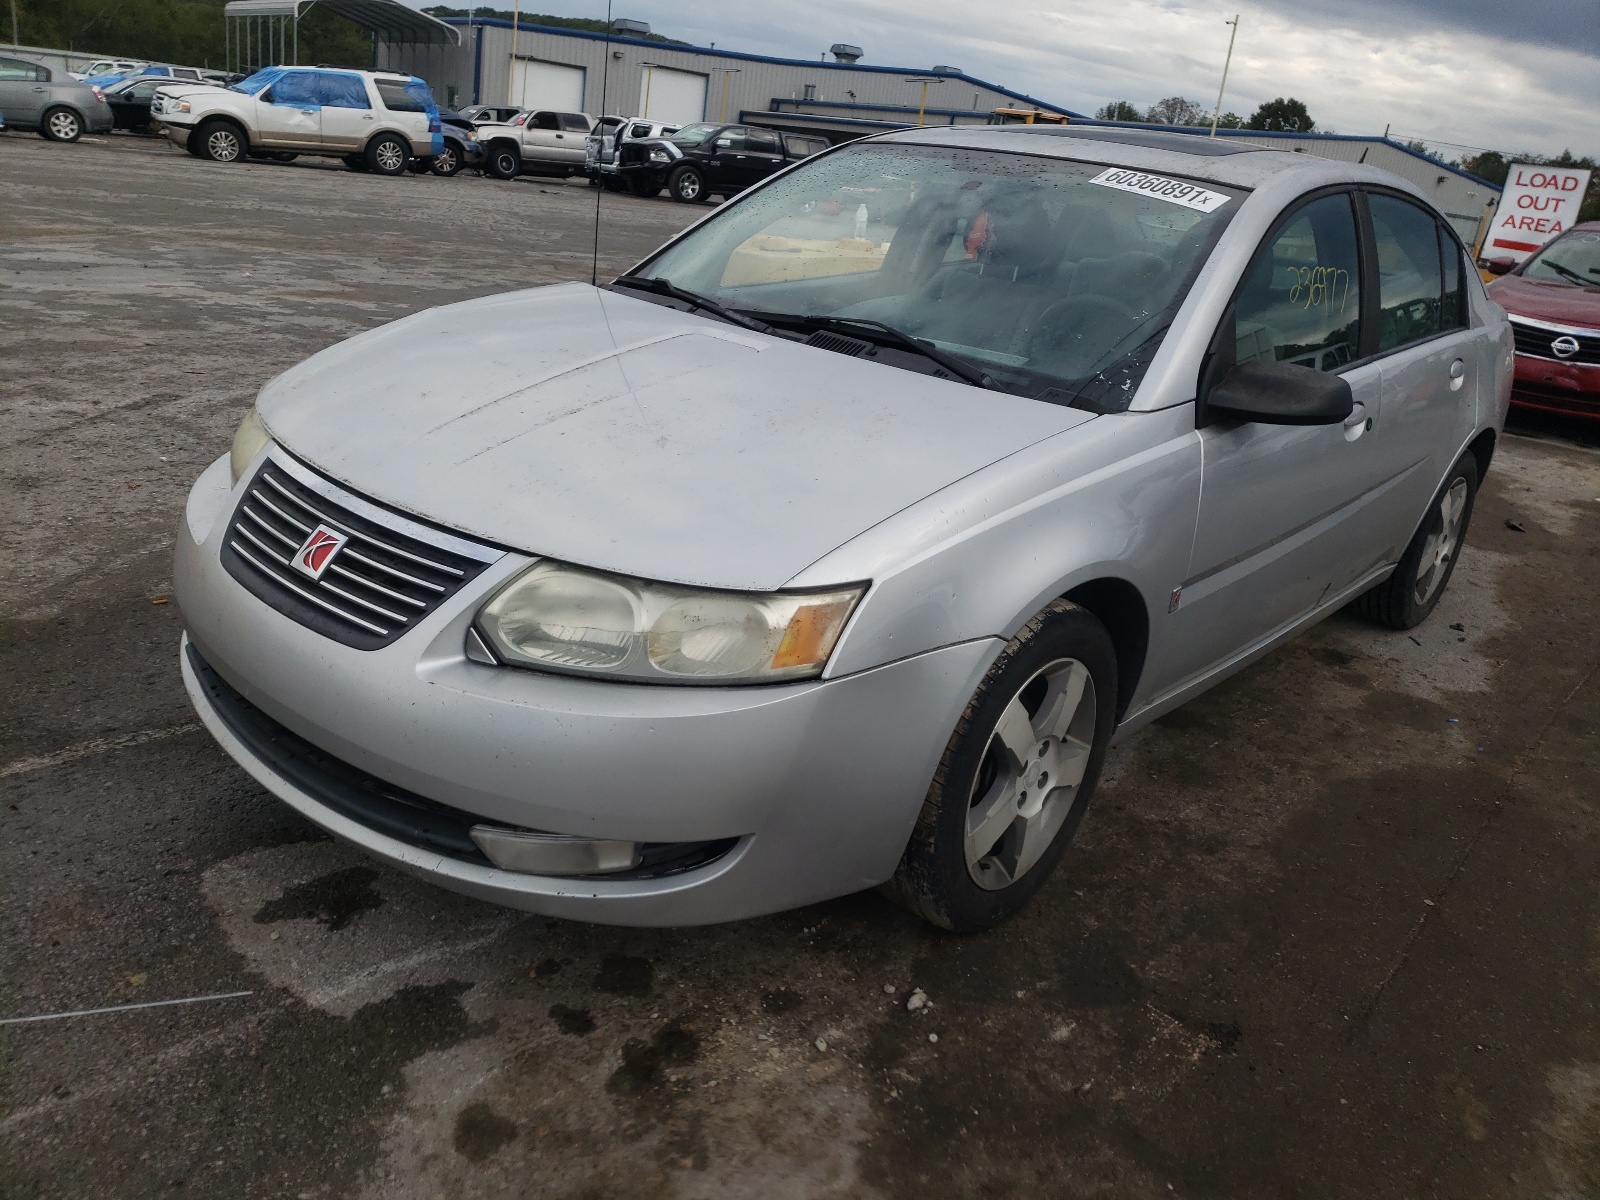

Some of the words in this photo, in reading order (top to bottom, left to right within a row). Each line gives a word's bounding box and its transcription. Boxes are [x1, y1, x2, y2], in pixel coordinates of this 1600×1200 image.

[1515, 171, 1579, 191] LOAD
[1517, 194, 1566, 213] OUT
[1501, 214, 1563, 234] AREA
